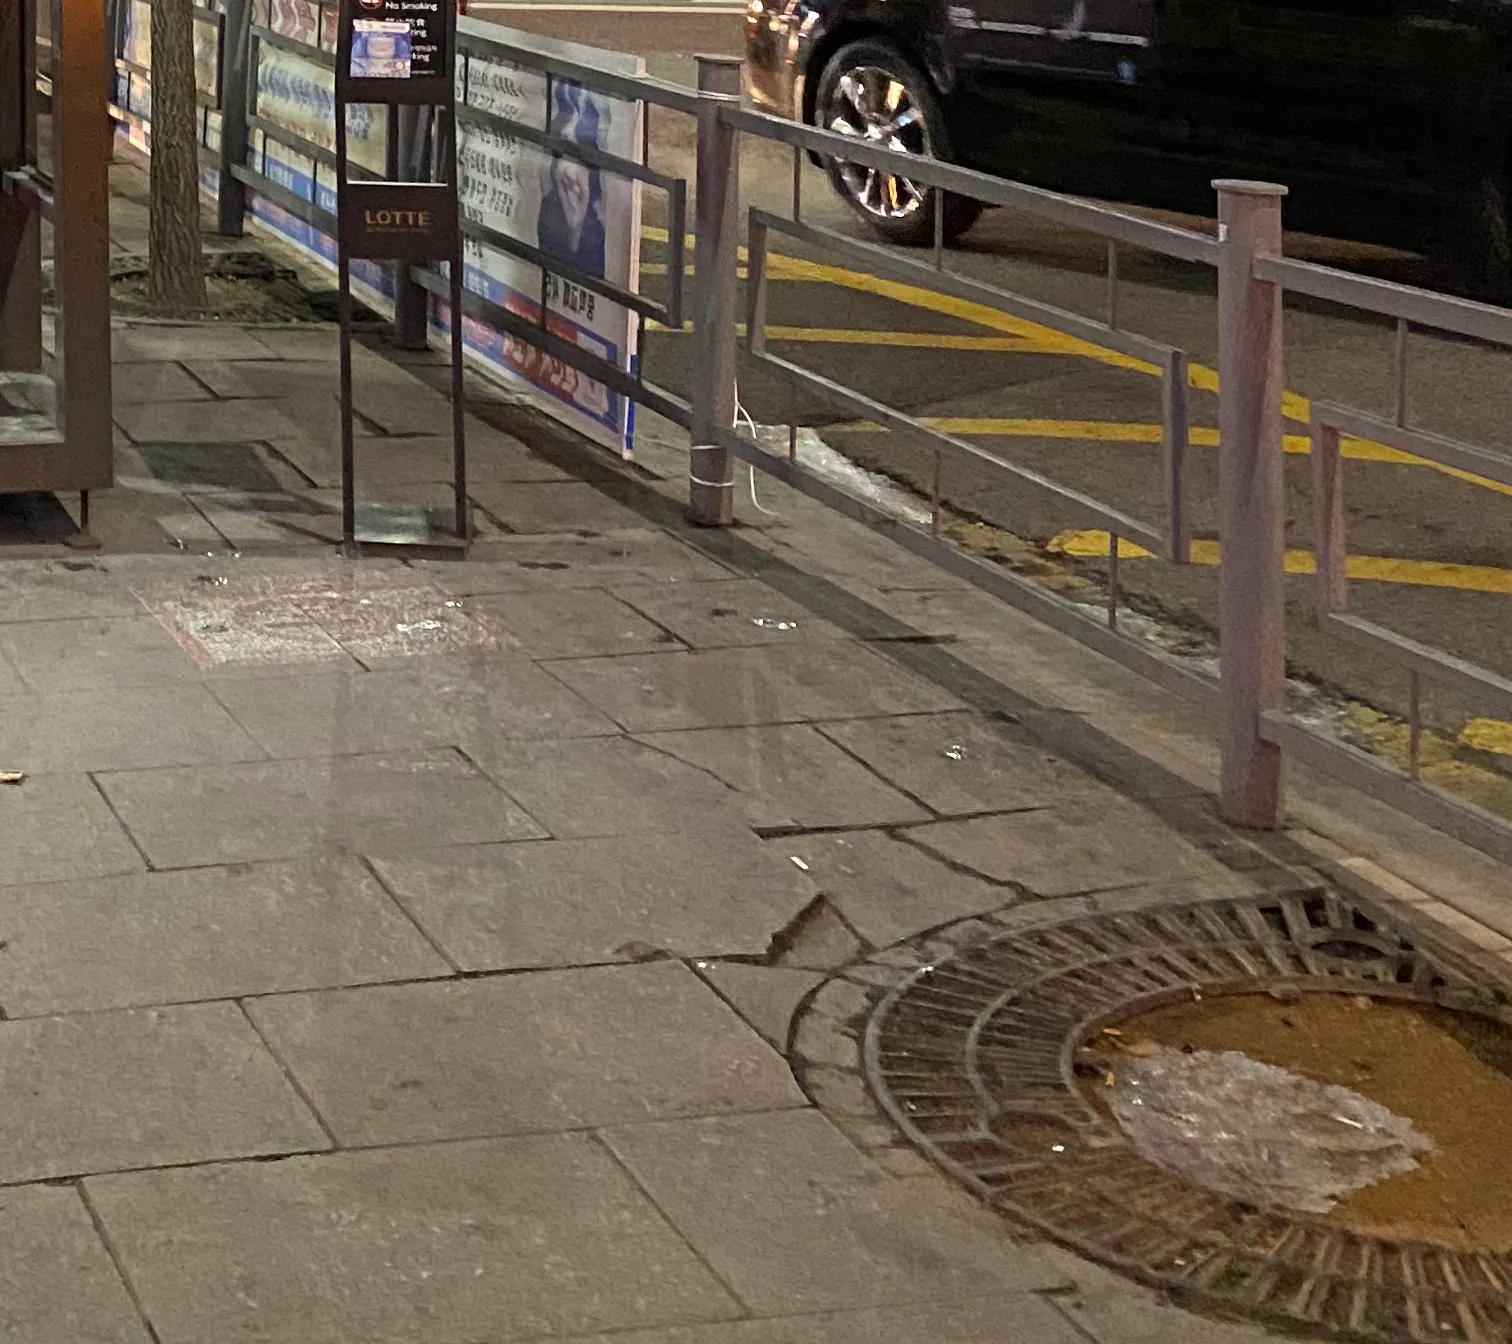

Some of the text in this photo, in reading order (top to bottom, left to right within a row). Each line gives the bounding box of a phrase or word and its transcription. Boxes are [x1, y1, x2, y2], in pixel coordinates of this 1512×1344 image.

[385, 1, 438, 12] No Smoking
[364, 210, 431, 227] LOTTE
